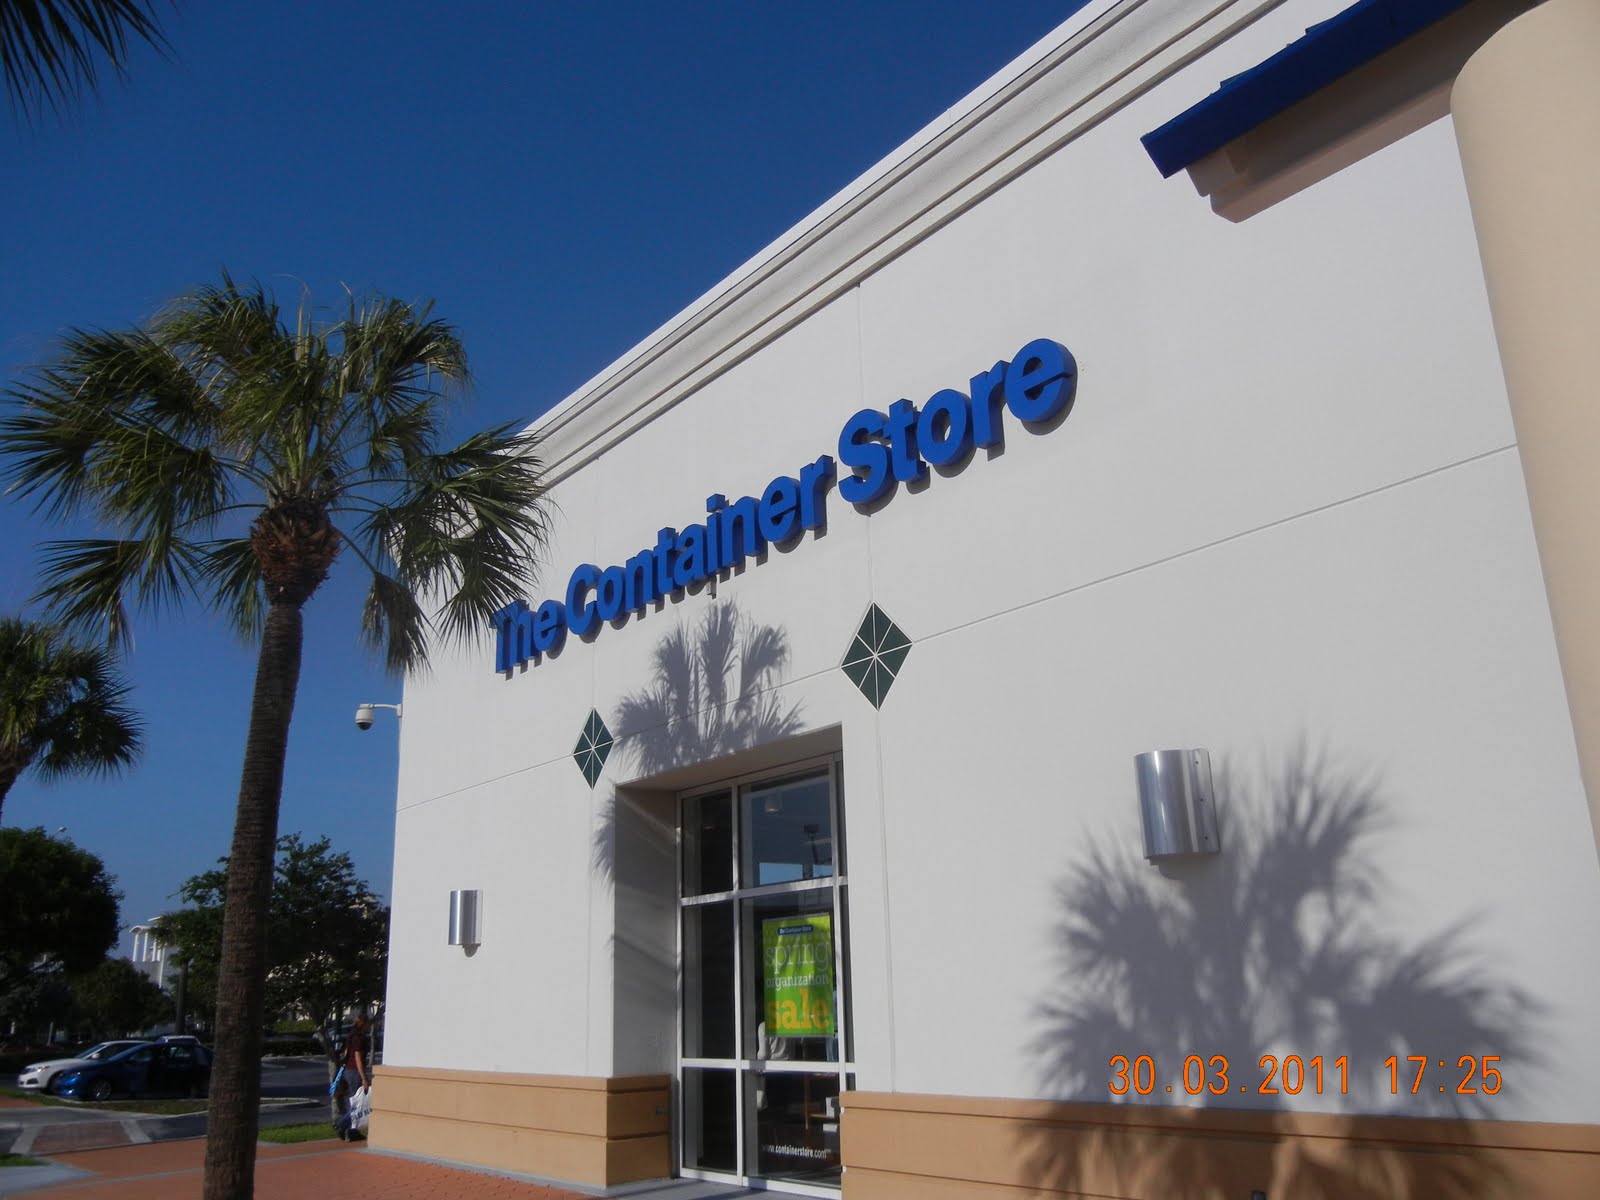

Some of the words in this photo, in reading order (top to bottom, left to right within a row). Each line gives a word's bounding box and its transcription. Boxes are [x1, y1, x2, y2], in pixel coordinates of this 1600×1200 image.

[489, 599, 567, 674] The
[564, 454, 835, 637] Container
[837, 337, 1075, 505] Store
[766, 942, 829, 974] spring
[766, 971, 829, 991] organization
[768, 988, 830, 1030] sale
